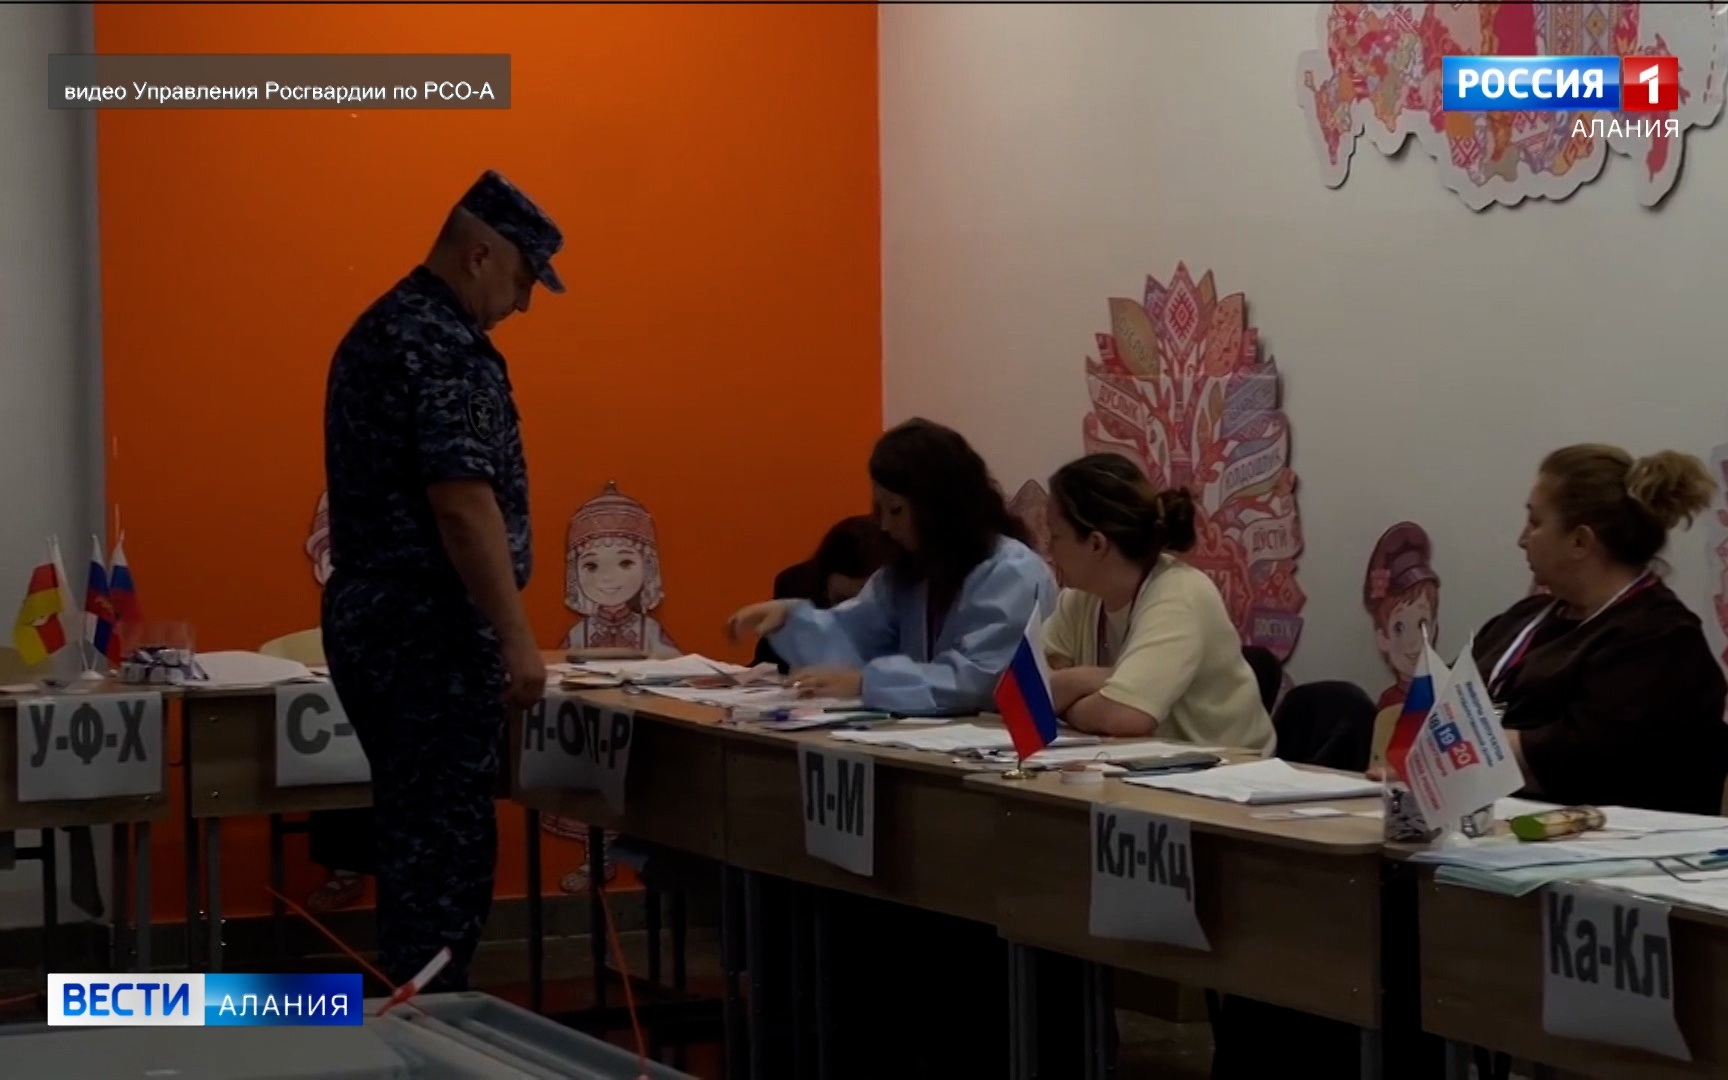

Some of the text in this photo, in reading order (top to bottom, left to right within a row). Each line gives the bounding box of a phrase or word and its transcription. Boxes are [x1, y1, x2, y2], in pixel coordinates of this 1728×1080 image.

[30, 702, 147, 768] У-Ф-Х
[1438, 725, 1455, 746] 19
[1451, 741, 1472, 766] 20
[1097, 811, 1191, 902] Кл-Кц
[1548, 891, 1670, 1000] Ка-Кл
